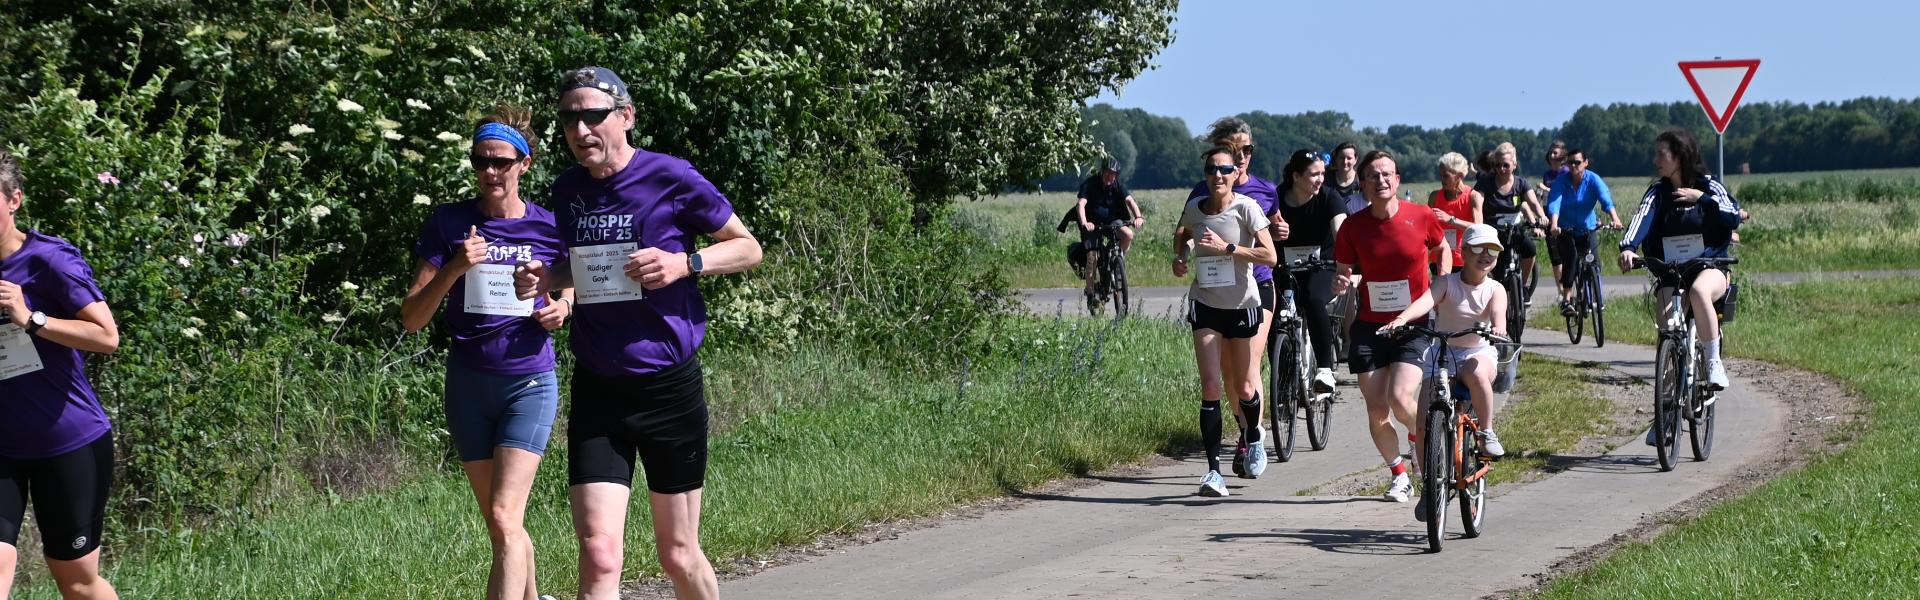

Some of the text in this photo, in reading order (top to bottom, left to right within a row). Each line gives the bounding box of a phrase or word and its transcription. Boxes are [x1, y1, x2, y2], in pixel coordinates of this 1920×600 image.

[577, 214, 634, 229] HOSPIZ
[576, 228, 633, 242] LAUF 25
[487, 245, 532, 255] OSPIZ
[485, 251, 512, 261] AUF
[587, 264, 613, 272] Rüdiger
[489, 289, 508, 297] Reiter
